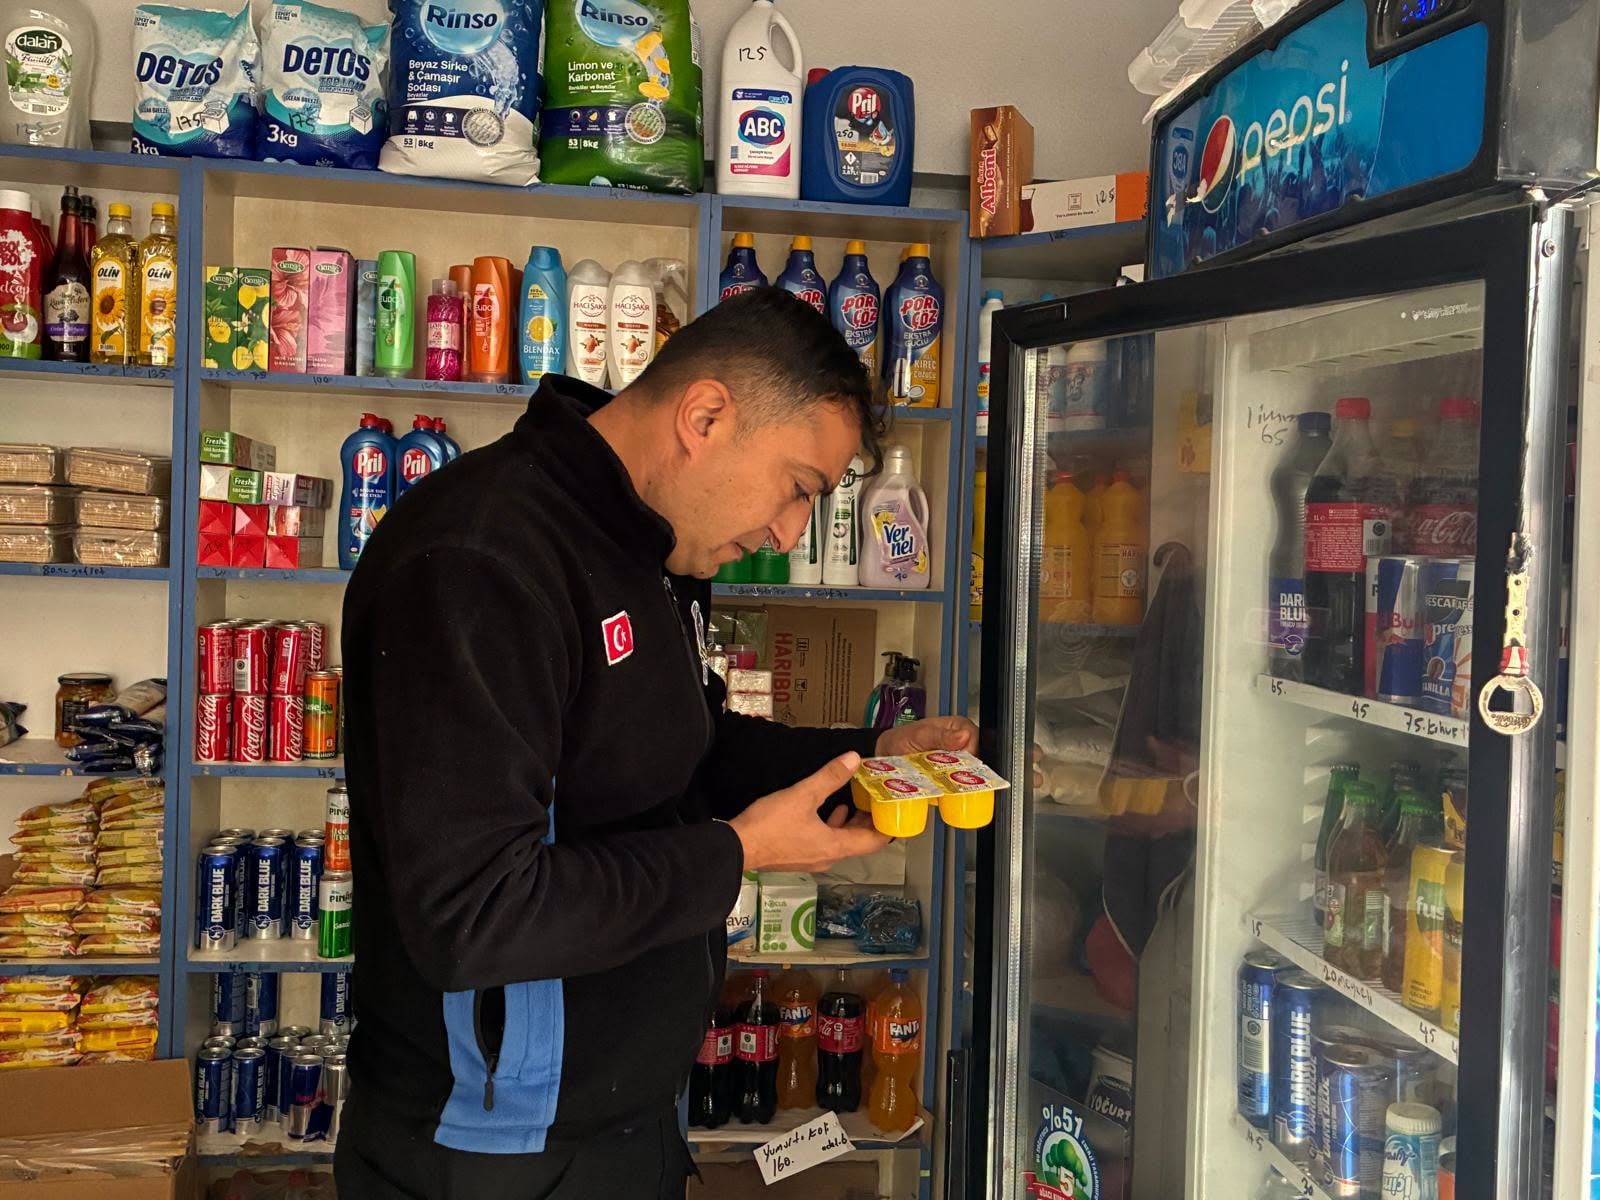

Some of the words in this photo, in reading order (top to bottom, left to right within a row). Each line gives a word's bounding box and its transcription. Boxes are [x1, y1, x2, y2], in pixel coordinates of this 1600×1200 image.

[427, 5, 498, 30] Rinso
[581, 0, 648, 27] Rinso
[17, 34, 57, 50] dalan
[738, 45, 767, 62] 125
[409, 60, 438, 71] Beyaz
[441, 60, 468, 72] Sirke
[568, 62, 598, 71] Limon
[600, 62, 614, 70] ve
[568, 71, 616, 82] Karbonat
[407, 83, 441, 93] Sodası
[408, 72, 415, 80] &
[417, 71, 461, 85] Çamaşır
[852, 93, 877, 115] Pril
[743, 117, 782, 138] ABC
[1237, 59, 1349, 184] pepsi
[267, 124, 298, 147] 3kg
[404, 138, 413, 147] 53
[418, 139, 434, 149] 8kg
[980, 148, 997, 215] Albeni
[842, 294, 874, 314] POR
[899, 295, 933, 316] POR
[851, 307, 878, 330] ÇÖZ
[911, 307, 938, 331] ÇÖZ
[903, 331, 932, 341] EKSTRA
[523, 344, 560, 355] BLENDAX
[1261, 423, 1288, 446] 65
[357, 452, 383, 475] Pril
[403, 454, 426, 476] Pril
[884, 524, 910, 545] Ver
[891, 536, 913, 558] nel
[773, 632, 793, 705] HARIBO
[1351, 700, 1370, 719] 45
[212, 867, 225, 895] BLUE
[258, 858, 271, 885] BLUE
[301, 859, 312, 885] BLUE
[258, 885, 270, 912] DARK
[300, 884, 311, 912] DARK
[1417, 895, 1446, 920] fus
[210, 895, 224, 924] DARK
[337, 971, 347, 992] BLUE
[335, 992, 346, 1014] DARK
[780, 1005, 812, 1021] FANTA
[1291, 1011, 1311, 1057] BLUE
[1419, 1020, 1437, 1044] 45
[1042, 1104, 1083, 1139] %51
